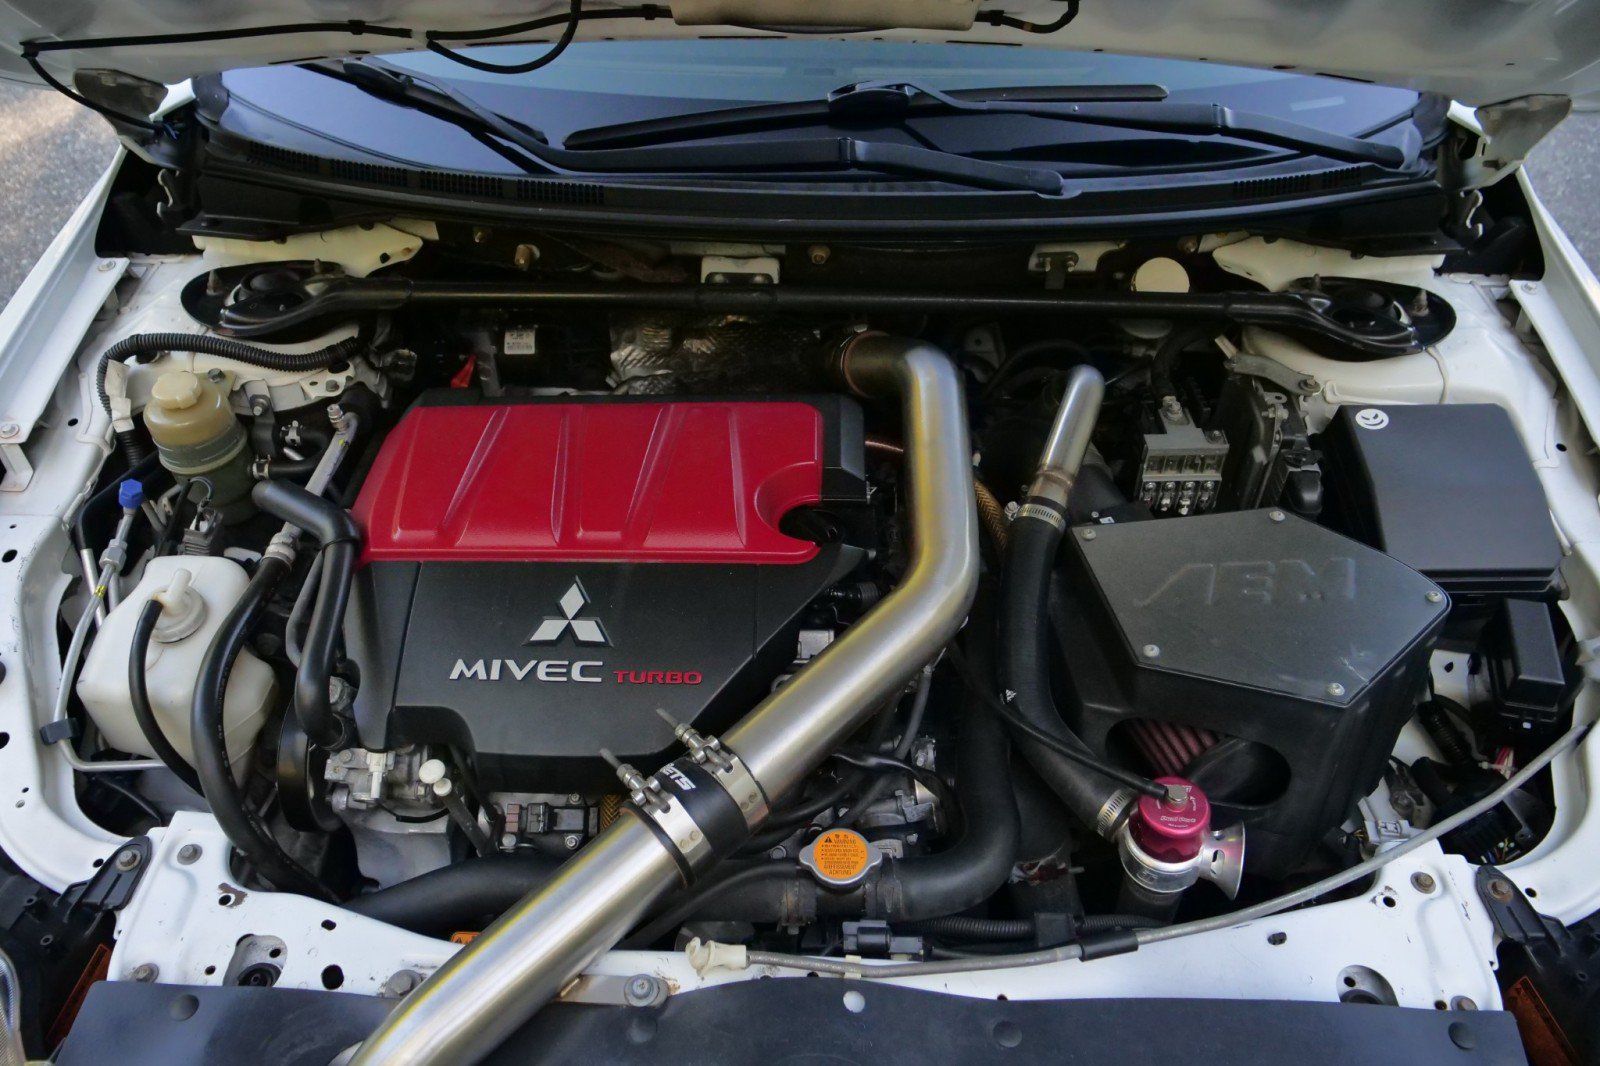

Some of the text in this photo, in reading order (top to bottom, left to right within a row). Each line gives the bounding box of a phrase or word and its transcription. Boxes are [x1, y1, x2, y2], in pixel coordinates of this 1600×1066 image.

[1134, 556, 1357, 606] AEM
[449, 658, 703, 685] MIVEC TURBO
